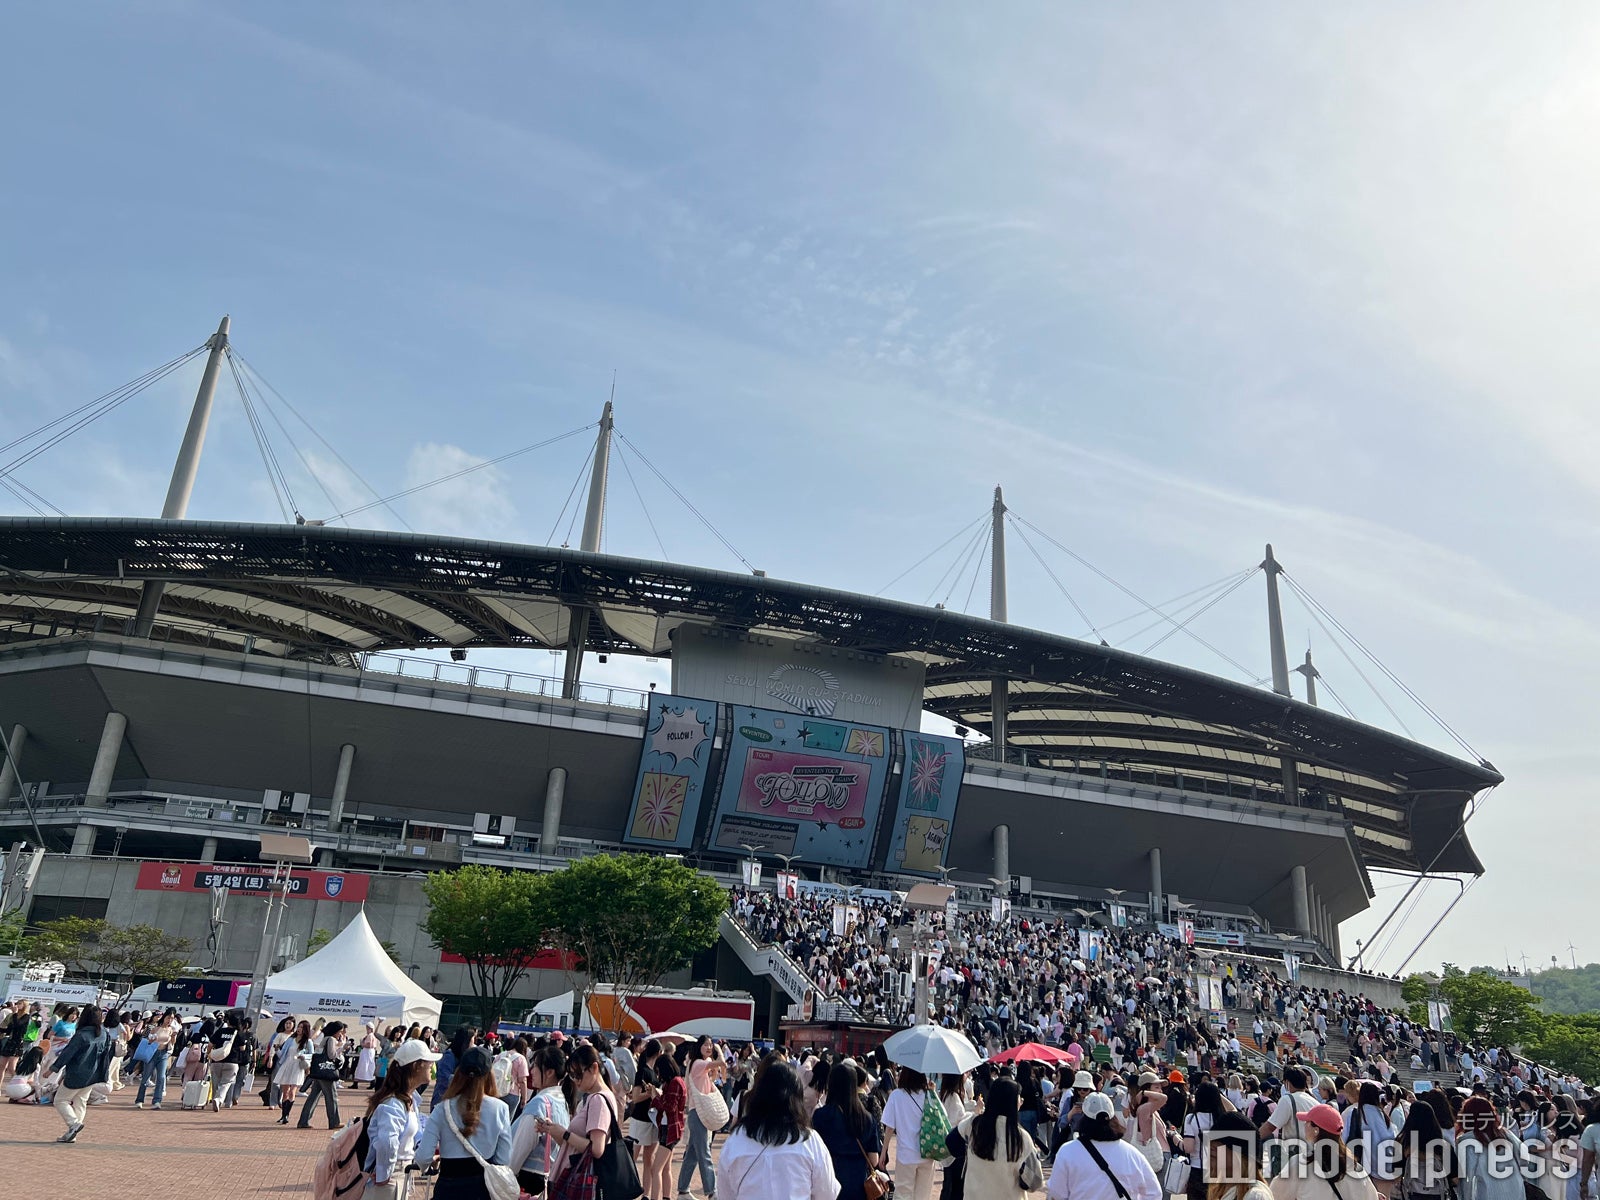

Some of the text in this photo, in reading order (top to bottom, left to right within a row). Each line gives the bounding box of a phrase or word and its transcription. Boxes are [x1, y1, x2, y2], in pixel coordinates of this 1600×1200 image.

[726, 674, 882, 707] SEOUL WORLD CUP STADIUM
[741, 727, 772, 740] SEVENTEEN
[755, 752, 770, 760] TOUR
[283, 795, 290, 803] H
[844, 820, 859, 828] AGAIN
[224, 876, 242, 889] 4일
[244, 876, 264, 889] (토)
